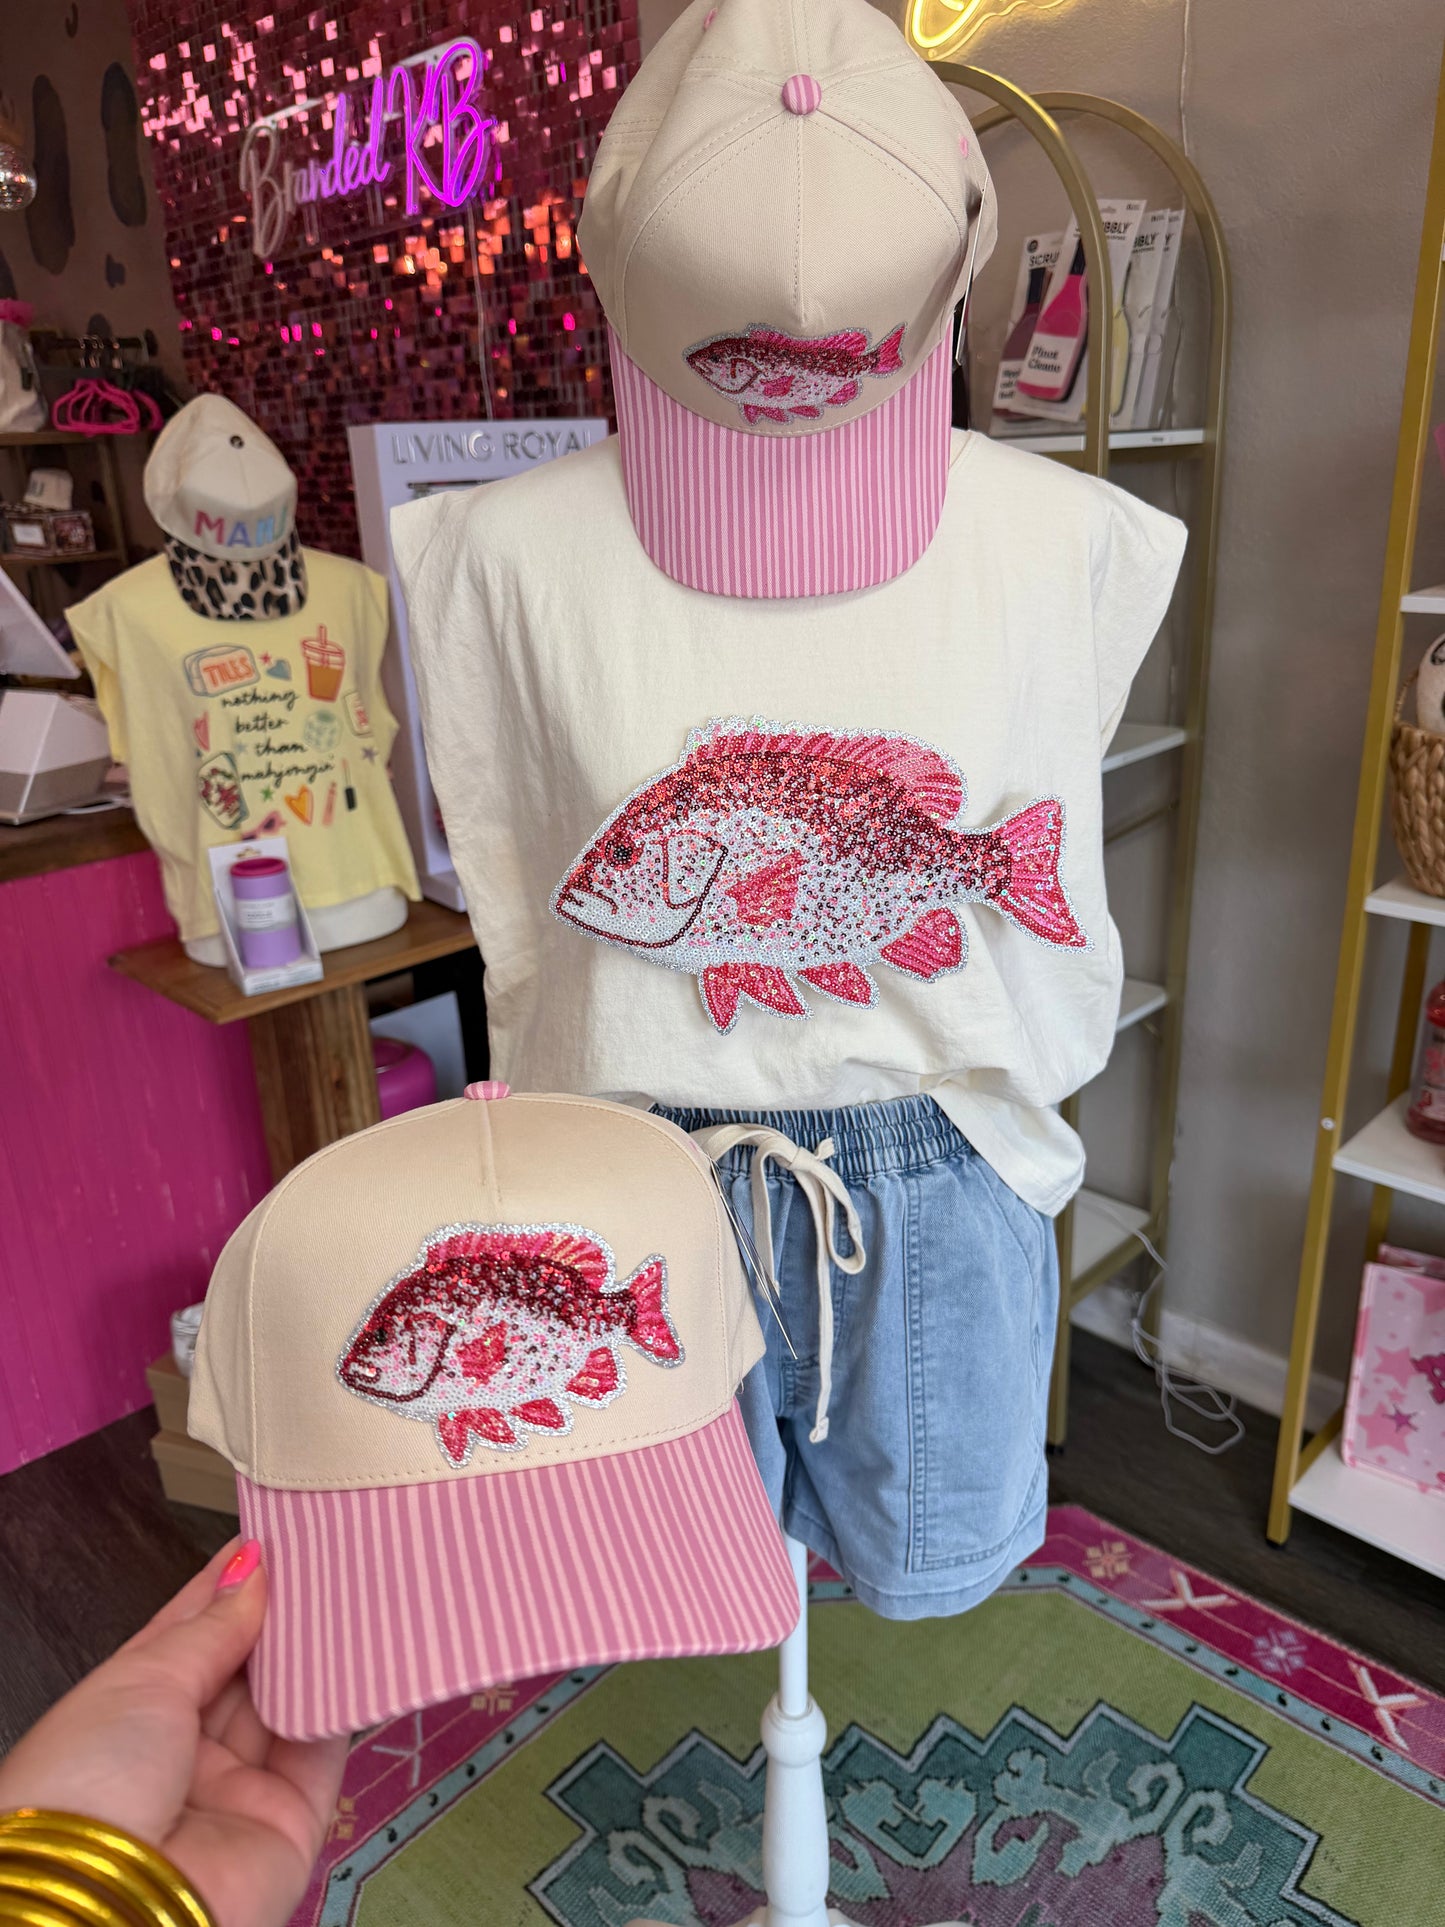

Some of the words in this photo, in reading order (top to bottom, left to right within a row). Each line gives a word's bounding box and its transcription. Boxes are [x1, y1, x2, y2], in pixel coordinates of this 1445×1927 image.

[239, 77, 391, 256] Branded
[388, 40, 493, 215] KB
[391, 431, 496, 464] LIVING
[203, 656, 255, 688] TILES
[222, 688, 299, 711] nothing
[235, 712, 289, 735] better
[255, 738, 307, 757] than
